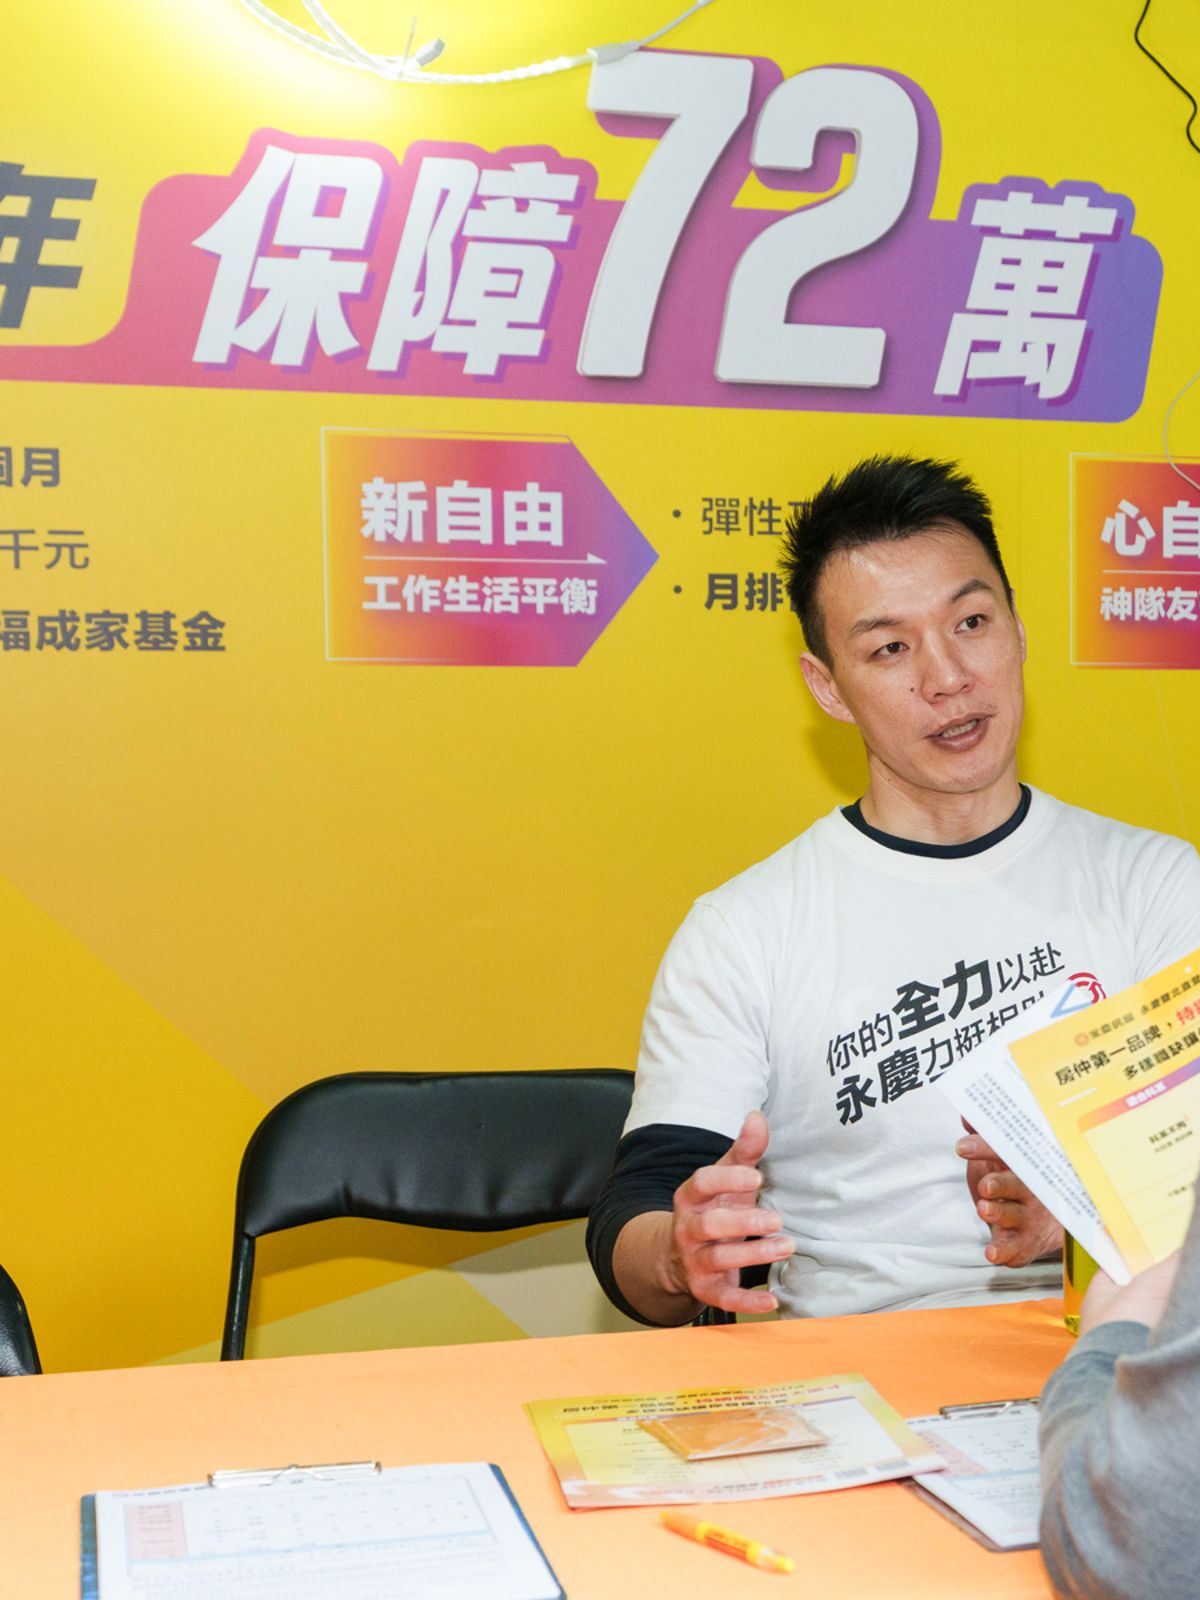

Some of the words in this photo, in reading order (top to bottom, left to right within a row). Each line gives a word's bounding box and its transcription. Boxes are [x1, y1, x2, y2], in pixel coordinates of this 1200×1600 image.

[360, 478, 565, 547] 新自由
[702, 497, 812, 536] 彈性
[0, 529, 90, 570] 千元
[362, 575, 599, 616] 工作生活平衡
[704, 572, 797, 612] 月排
[0, 609, 226, 652] 福成家基金
[826, 942, 1065, 1076] 你的全力以赴
